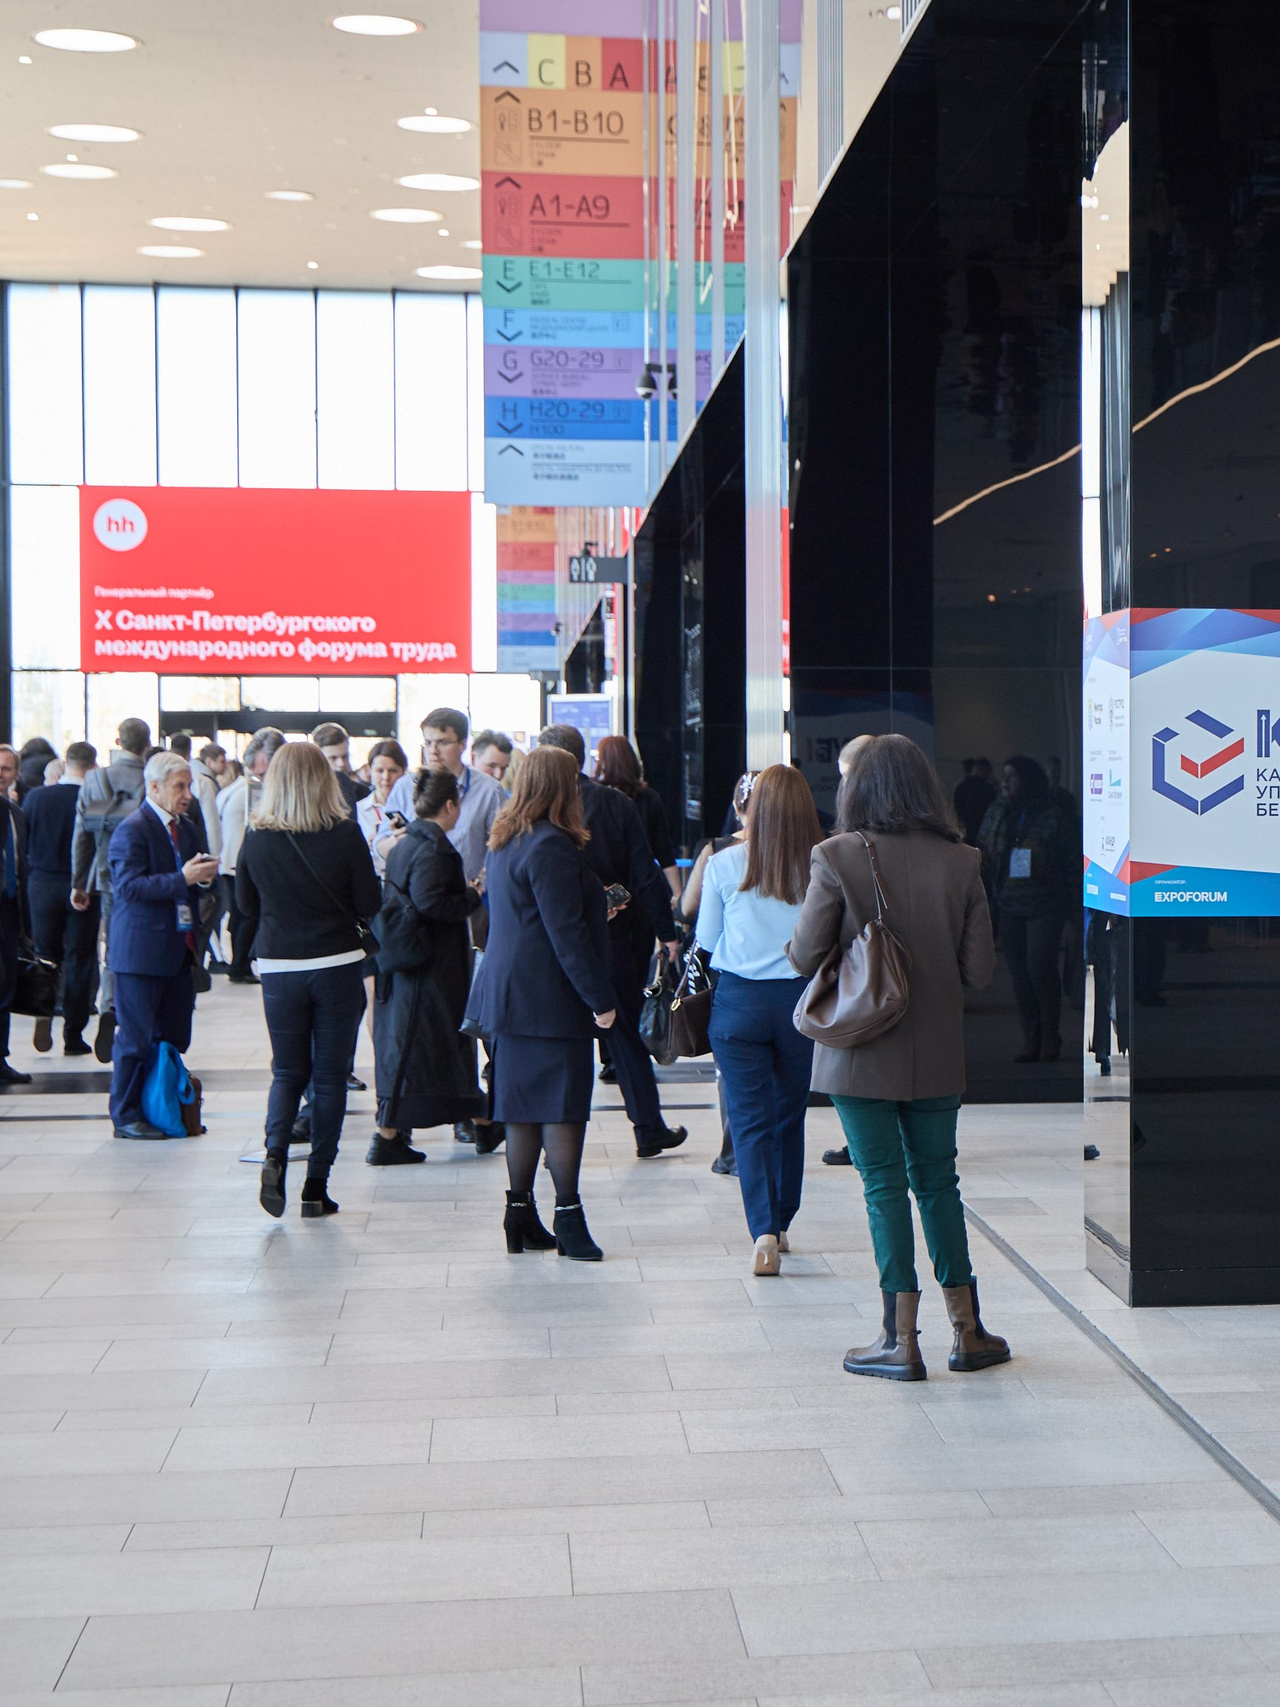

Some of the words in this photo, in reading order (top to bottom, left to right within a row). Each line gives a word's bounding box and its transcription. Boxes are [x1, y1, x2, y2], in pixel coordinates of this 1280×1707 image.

[538, 58, 555, 86] C
[575, 60, 592, 87] B
[609, 62, 629, 89] A
[528, 107, 624, 136] B1-B10
[529, 193, 610, 220] A1-A9
[503, 260, 514, 281] E
[529, 260, 600, 279] E1-E12
[503, 349, 518, 371] G
[530, 349, 604, 368] G20-29
[502, 401, 518, 420] H
[529, 400, 605, 419] H20-29
[107, 516, 134, 533] hh
[115, 609, 376, 636] Санкт-Петербургского
[94, 639, 295, 661] международного
[297, 637, 388, 662] форума
[389, 642, 457, 662] труда
[1154, 891, 1228, 902] EXPOFORUM
